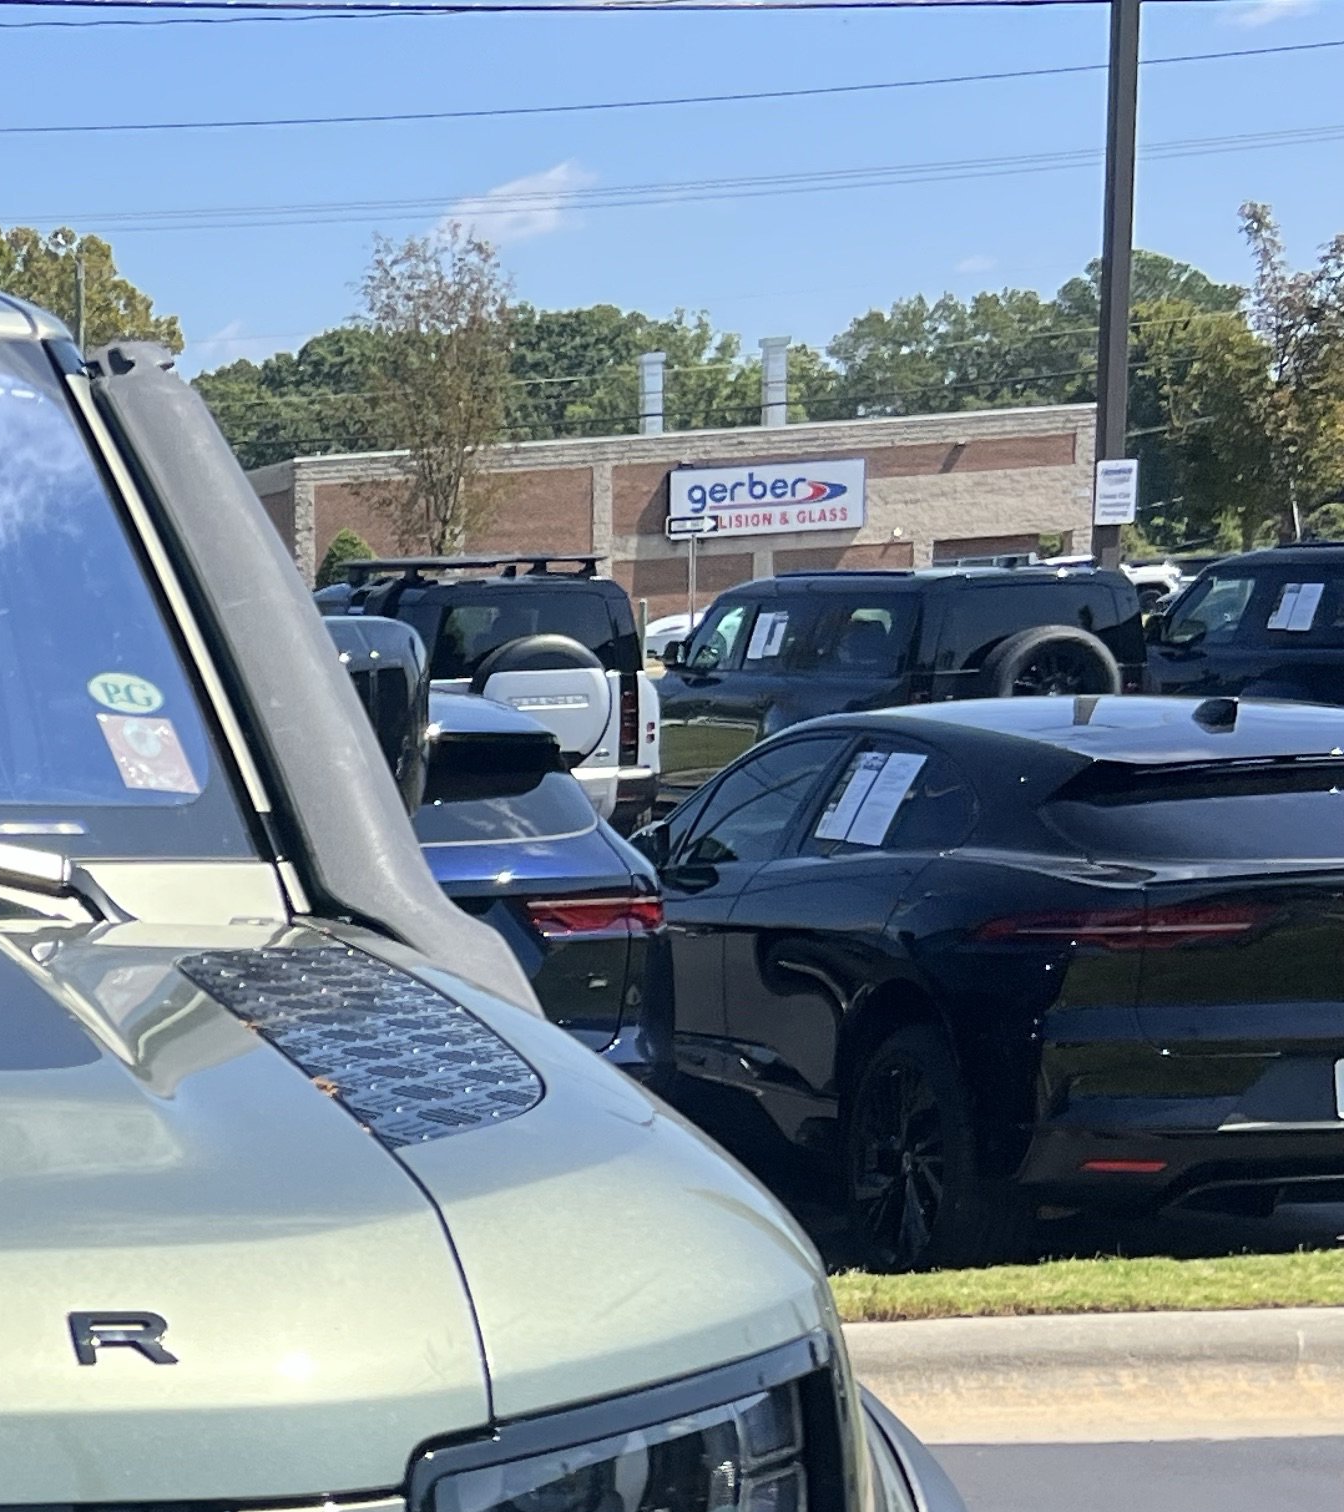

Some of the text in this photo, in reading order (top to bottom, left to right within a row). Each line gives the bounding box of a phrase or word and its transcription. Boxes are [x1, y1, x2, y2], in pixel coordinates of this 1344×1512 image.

[687, 471, 807, 514] gerber
[718, 513, 773, 530] LISION
[779, 512, 790, 525] &
[796, 507, 849, 524] GLASS
